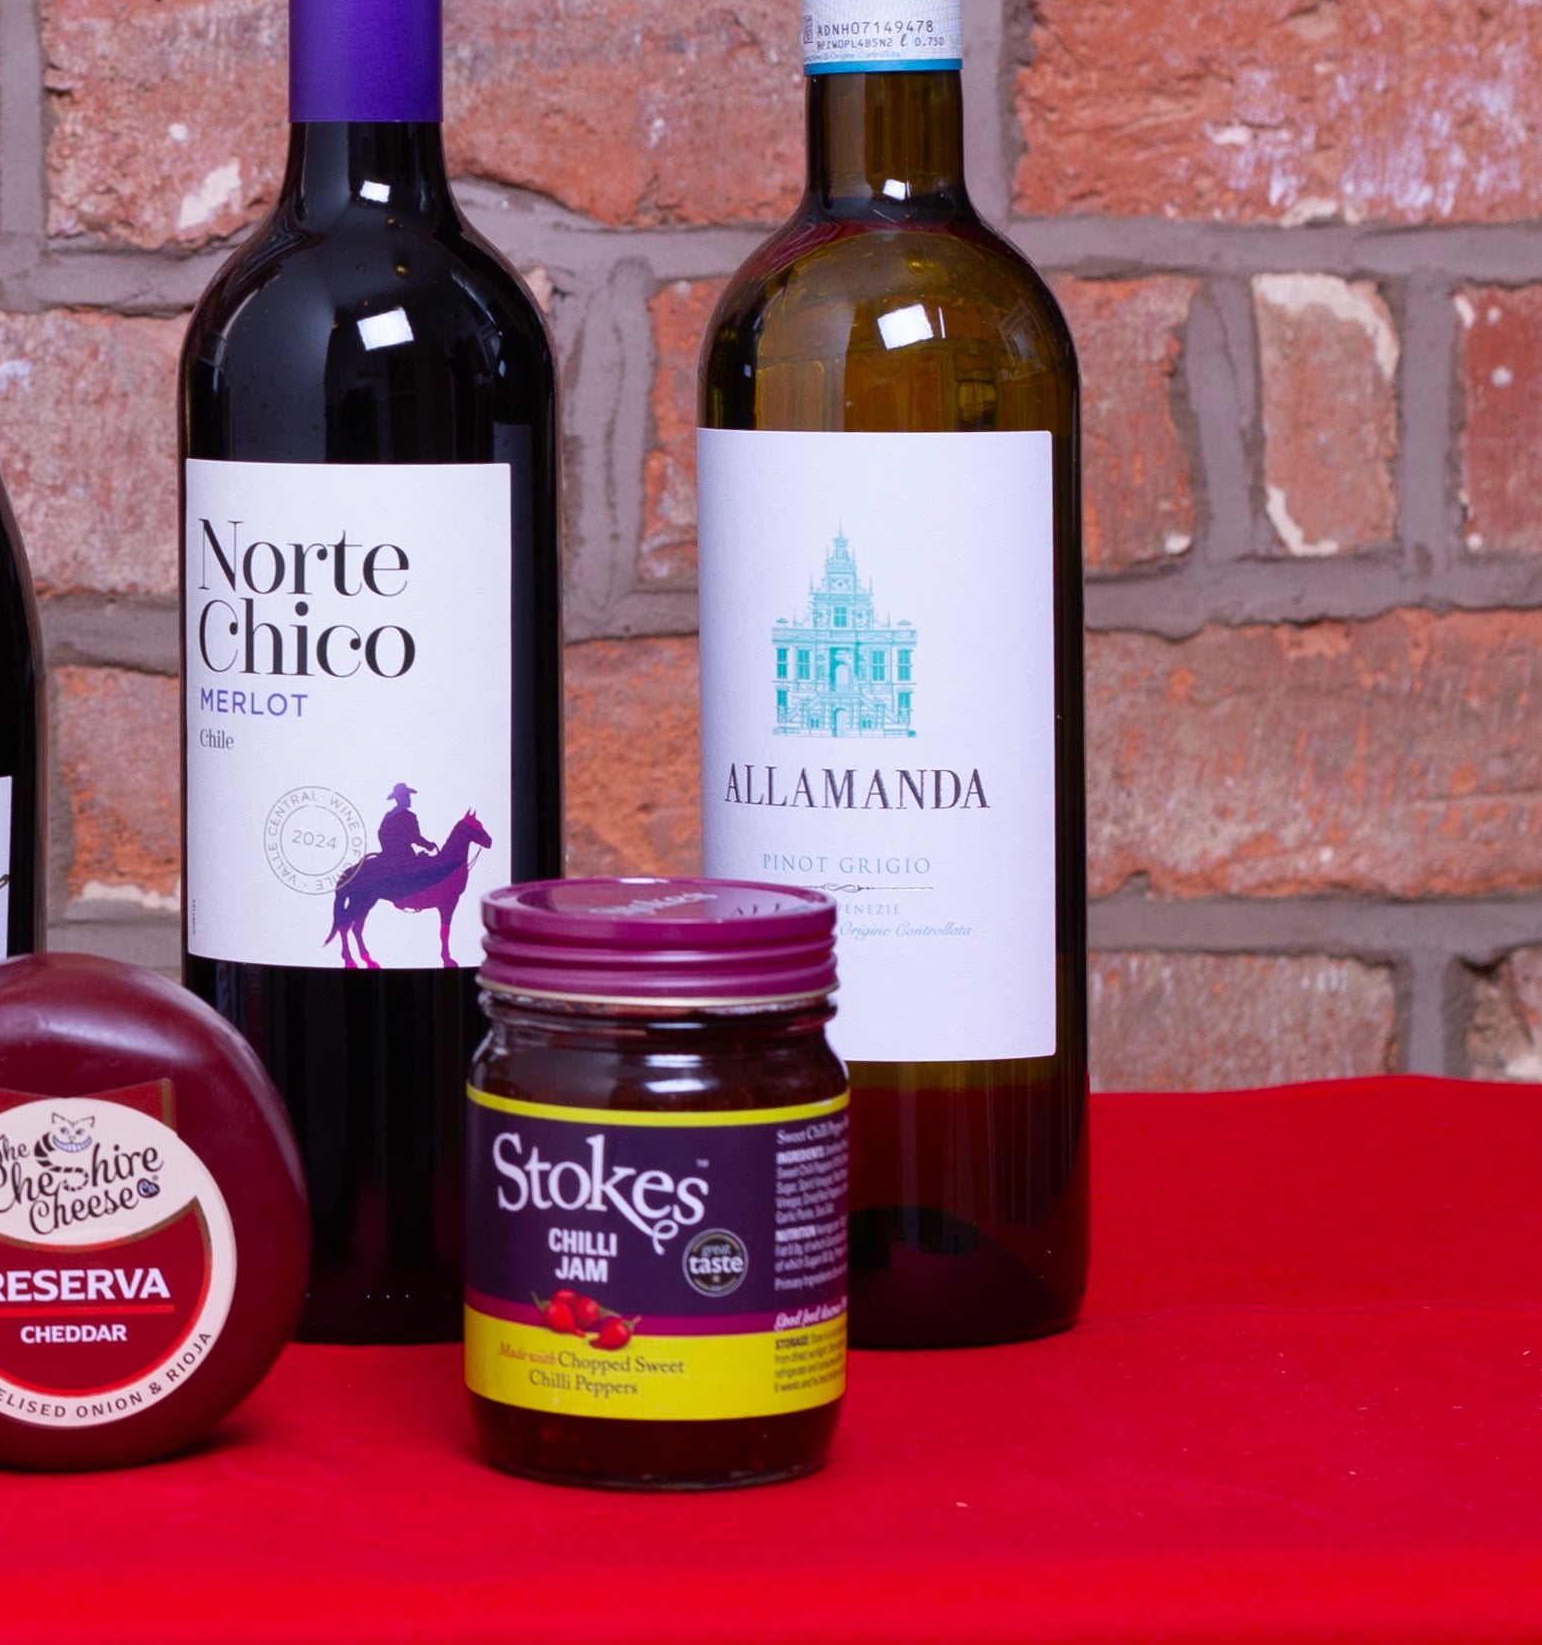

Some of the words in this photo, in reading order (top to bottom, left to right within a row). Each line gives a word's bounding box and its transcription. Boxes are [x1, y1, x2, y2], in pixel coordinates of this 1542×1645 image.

[198, 518, 411, 598] Norte
[199, 598, 416, 679] Chico
[200, 687, 309, 717] MERLOT
[199, 728, 234, 750] Chile
[724, 762, 992, 812] ALLAMANDA
[268, 791, 317, 837] CENTRAL
[330, 796, 361, 831] WINE
[351, 836, 363, 858] OF
[291, 829, 337, 851] 2024
[268, 842, 297, 885] VALLE
[763, 853, 828, 873] PINOT
[839, 857, 932, 875] GRIGIO
[839, 921, 892, 941] Origine
[896, 920, 972, 937] Controllata
[28, 1184, 139, 1235] Cheese
[492, 1131, 710, 1256] Stokes
[548, 1226, 617, 1258] CHILLI
[554, 1256, 609, 1284] JAM
[688, 1254, 745, 1275] taste
[20, 1324, 128, 1345] CHEDDAR
[76, 1390, 144, 1420] ONION
[148, 1381, 164, 1396] &
[166, 1330, 213, 1383] RIOJA
[557, 1349, 631, 1376] Chopped
[635, 1355, 686, 1374] Sweet
[528, 1367, 571, 1391] Chilli
[574, 1373, 639, 1399] Peppers
